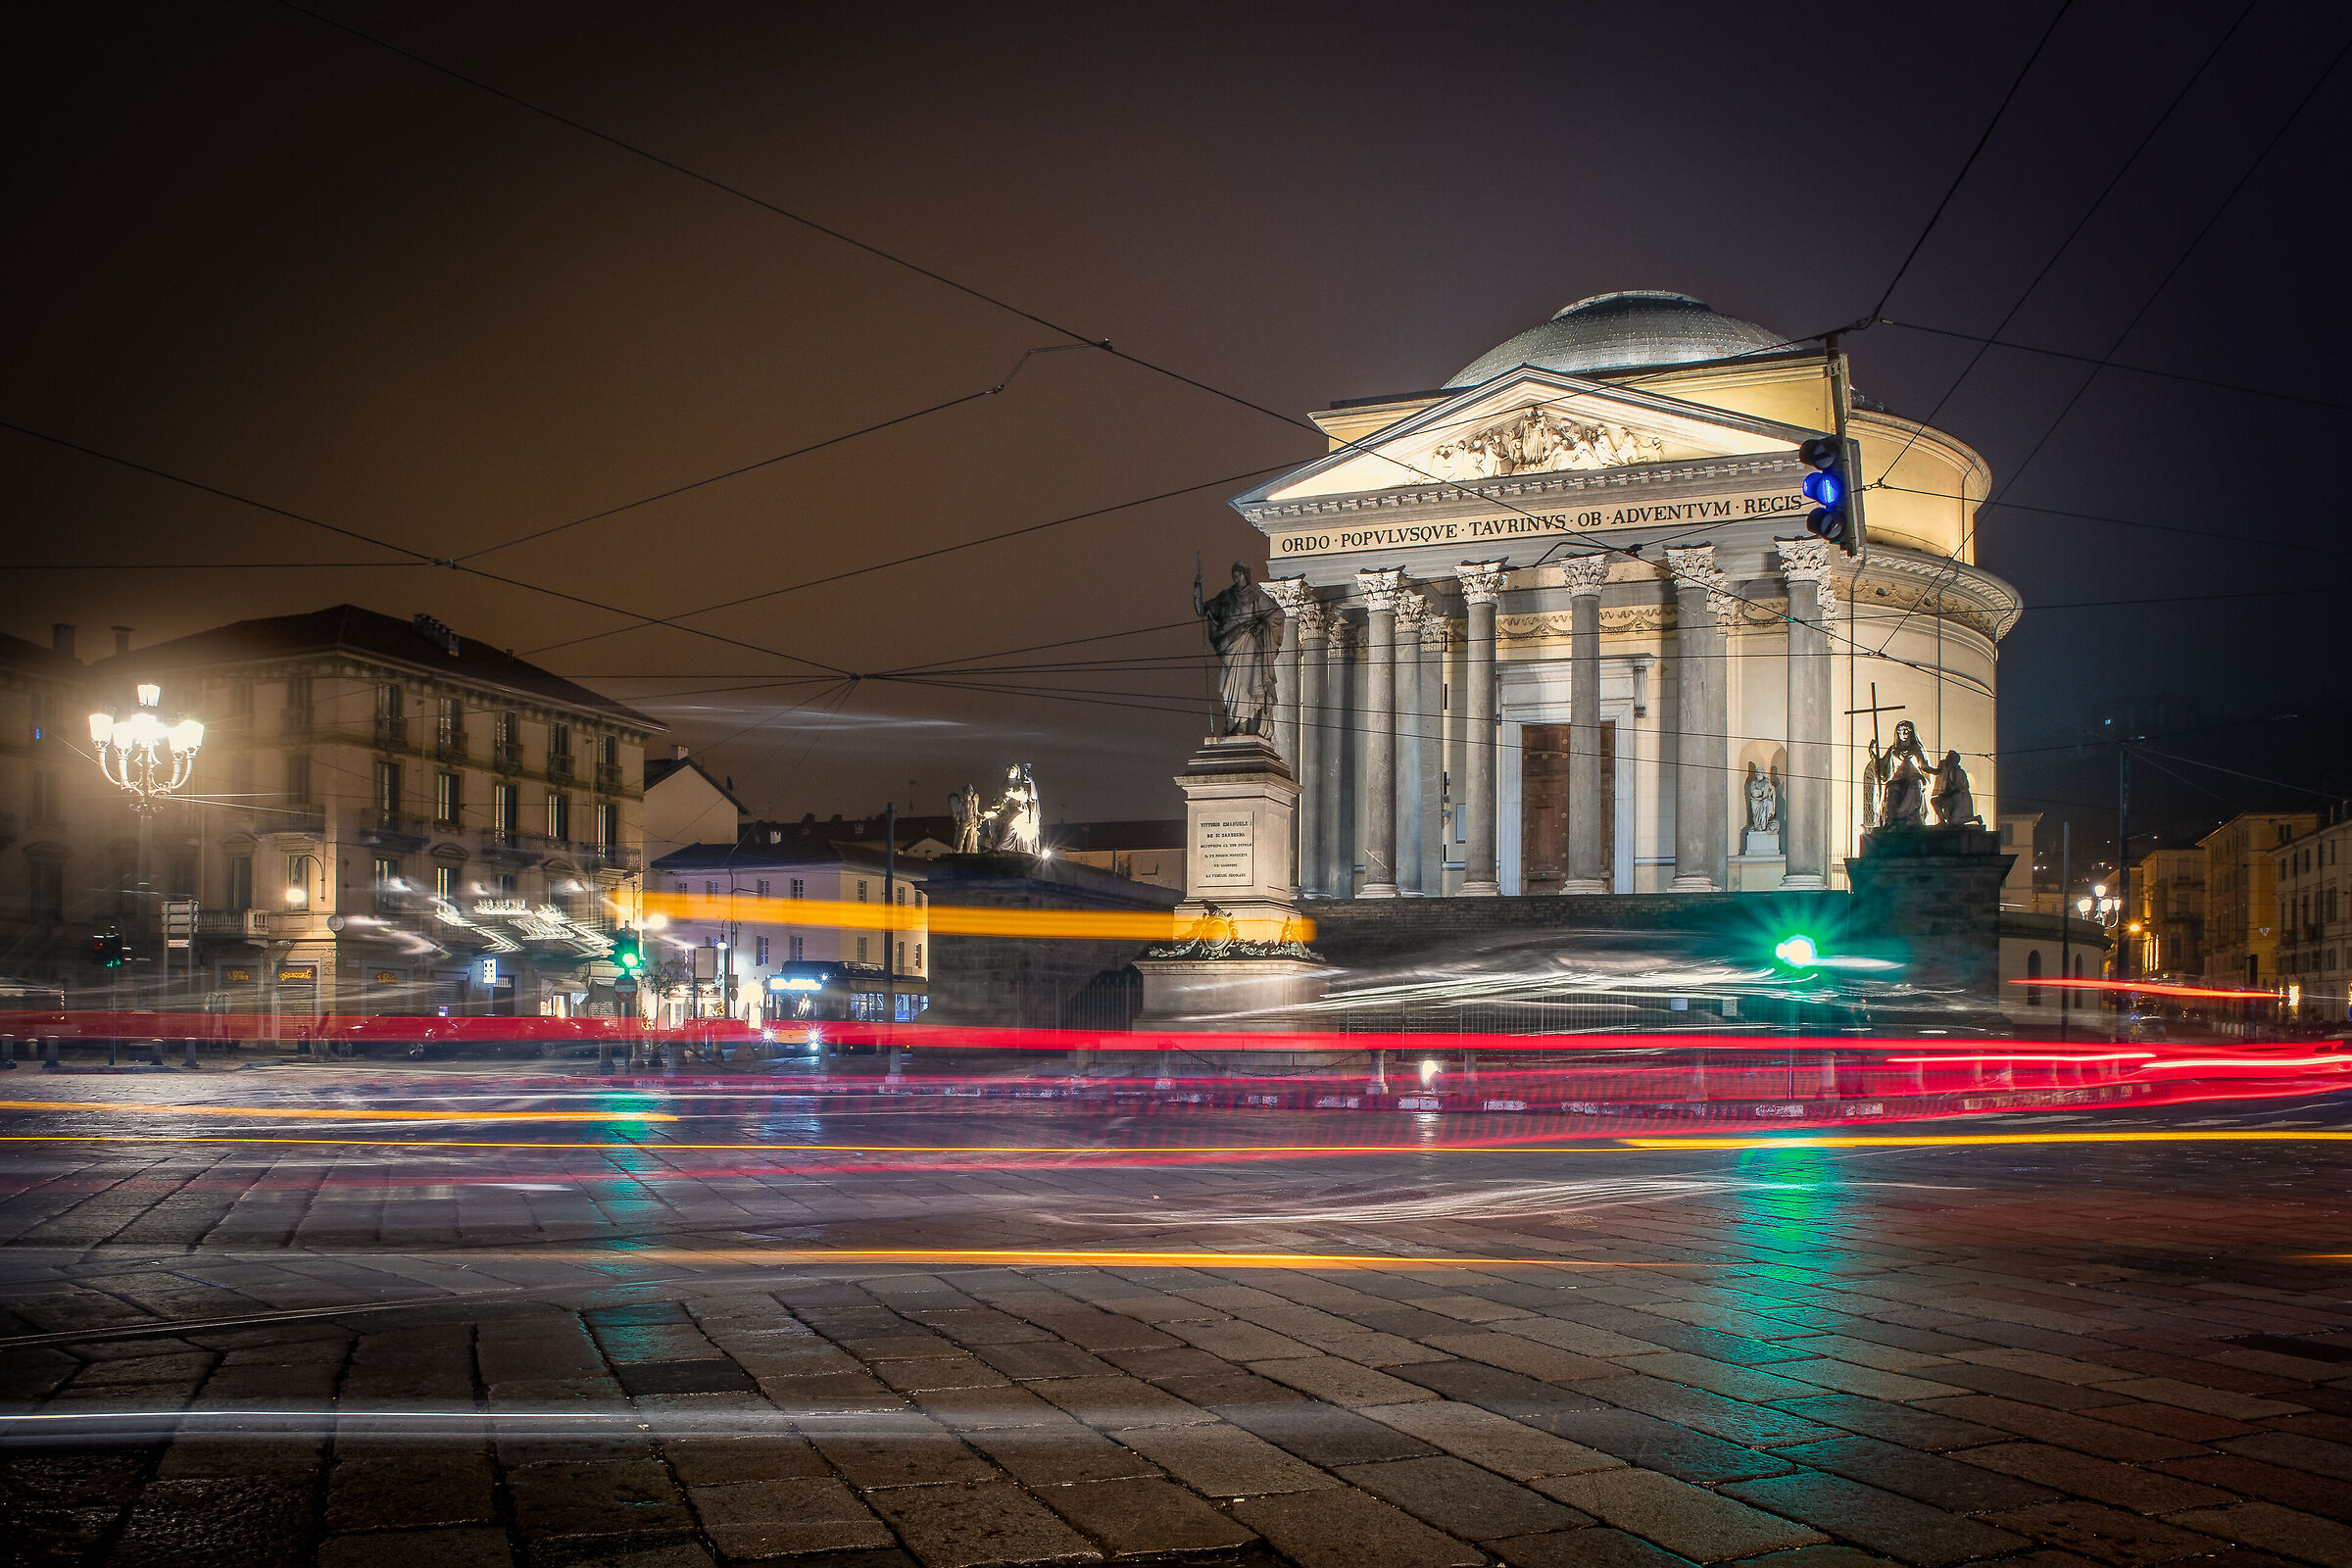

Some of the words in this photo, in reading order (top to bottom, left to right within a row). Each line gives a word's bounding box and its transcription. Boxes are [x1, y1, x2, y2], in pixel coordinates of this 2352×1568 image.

[1282, 534, 1330, 552] ORDO
[1341, 523, 1458, 548] POPVLVSQVE
[1469, 514, 1566, 536] TAVRINVS
[1578, 512, 1602, 527] OB
[1611, 500, 1732, 524] ADVENTVM
[1743, 495, 1803, 514] REGIS
